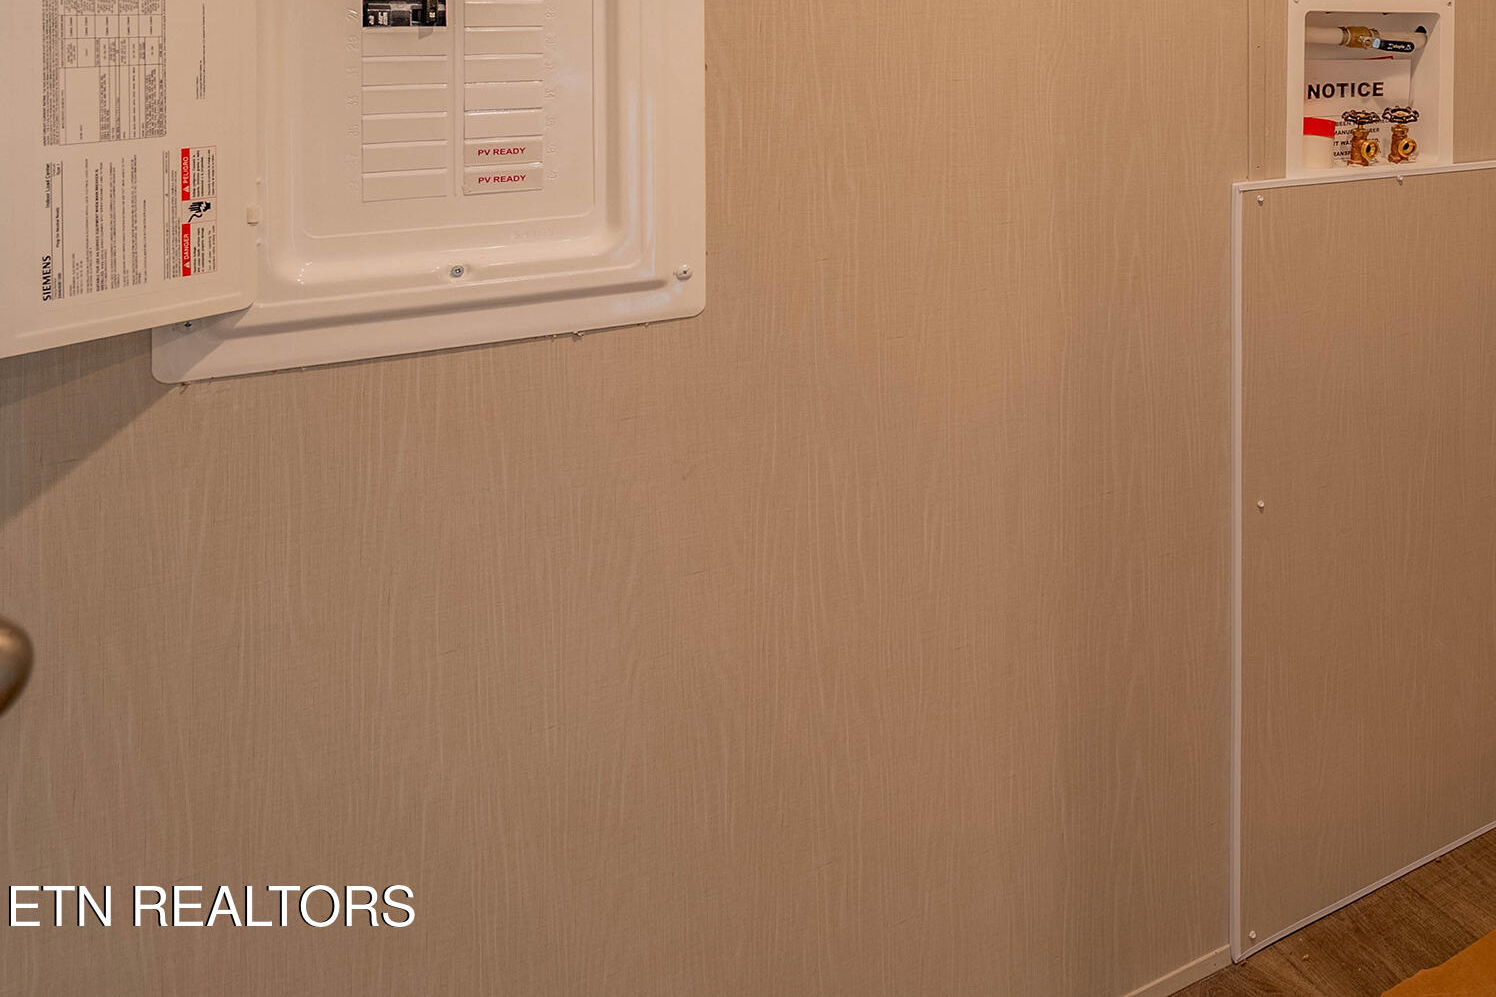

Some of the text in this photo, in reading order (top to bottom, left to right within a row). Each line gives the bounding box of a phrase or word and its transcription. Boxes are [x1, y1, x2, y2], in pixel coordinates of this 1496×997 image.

[1307, 82, 1384, 99] NOTICE
[492, 147, 526, 155] READY
[478, 174, 526, 184] PV READY
[42, 255, 52, 301] SIEMENS
